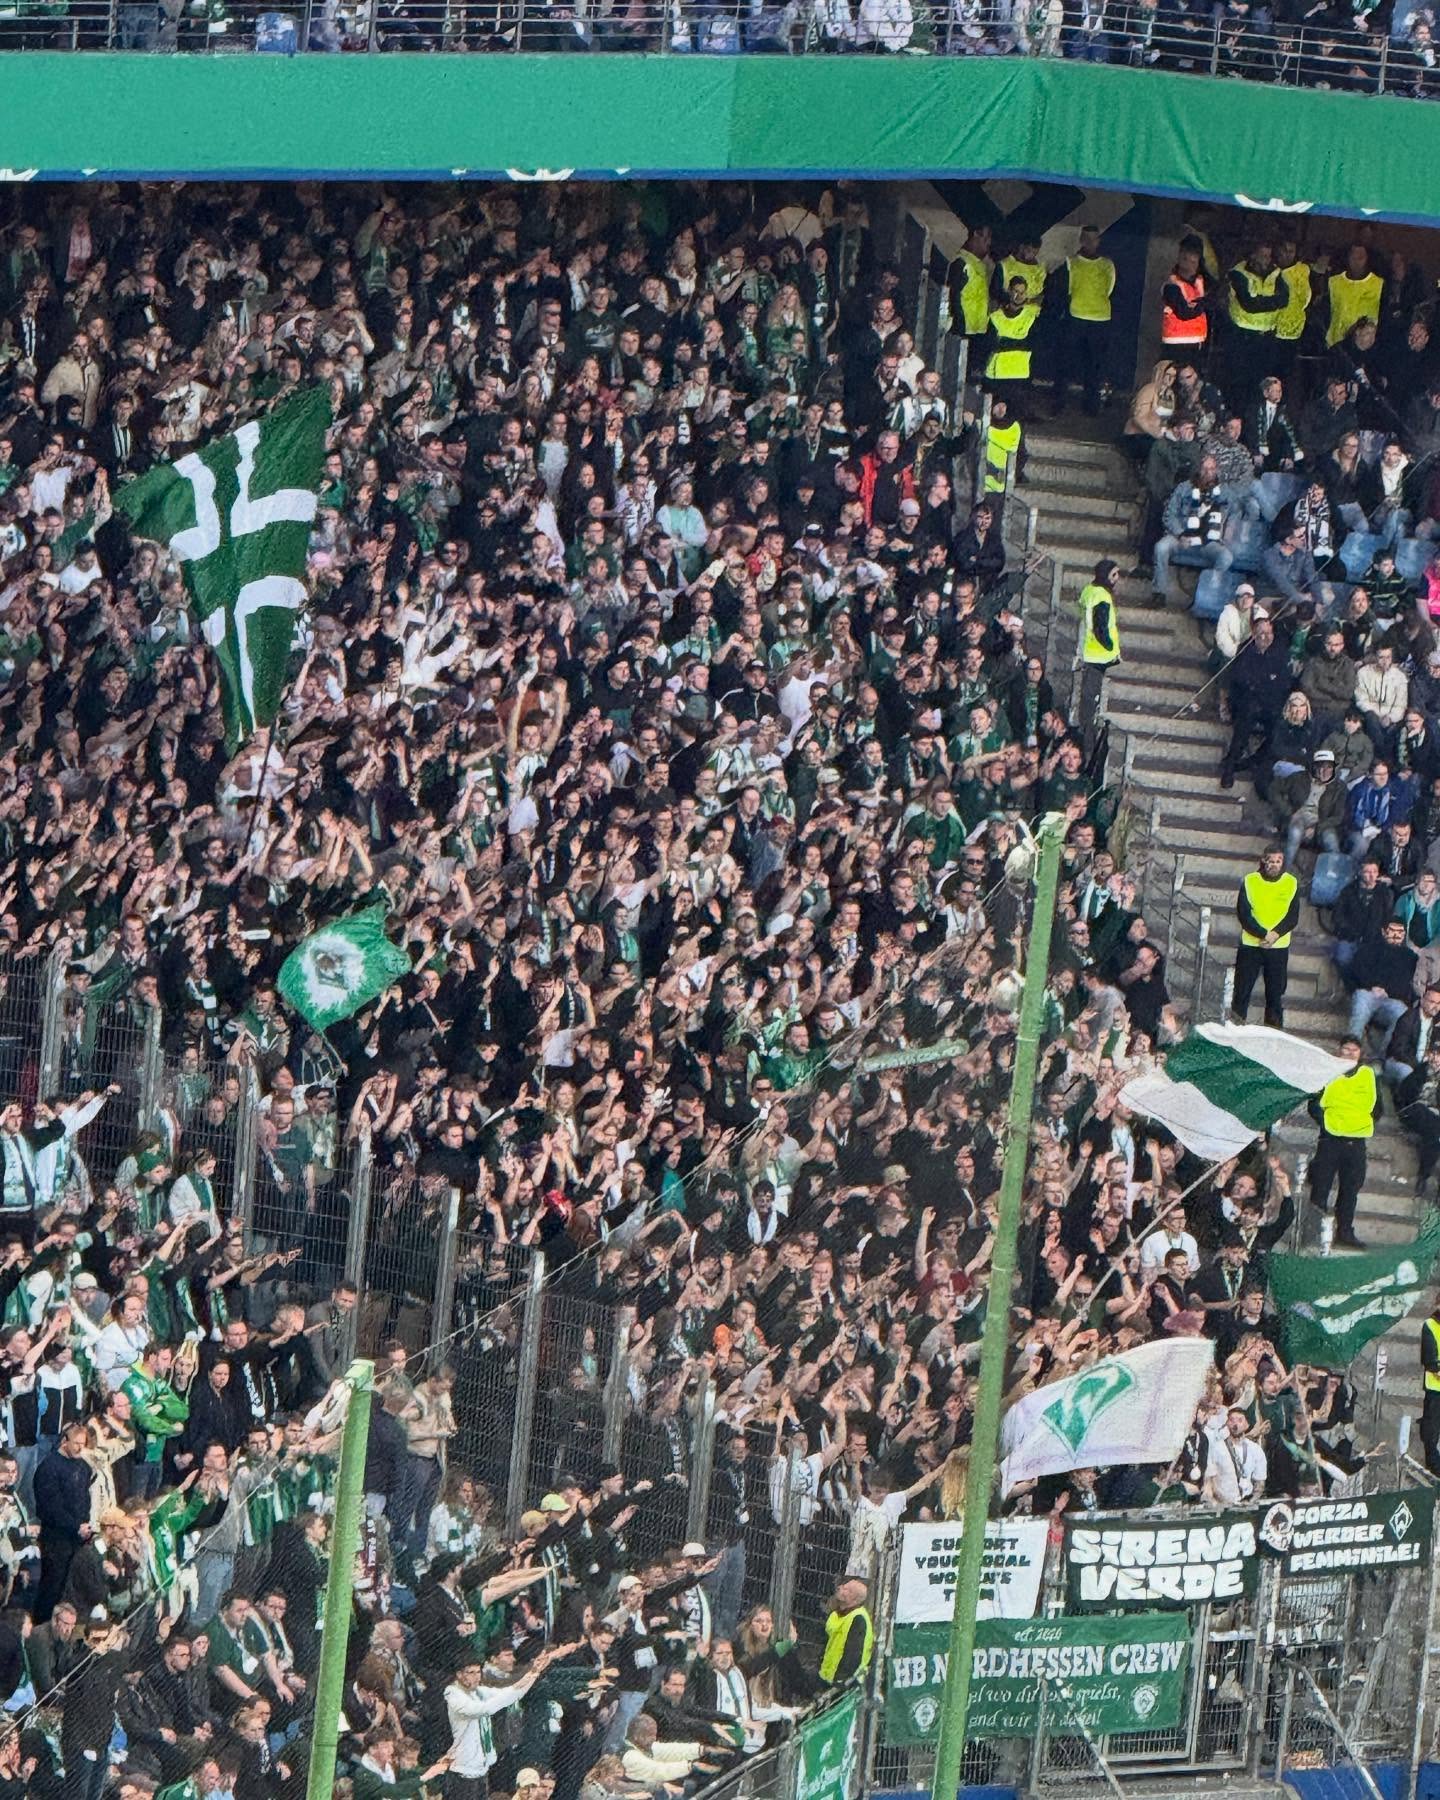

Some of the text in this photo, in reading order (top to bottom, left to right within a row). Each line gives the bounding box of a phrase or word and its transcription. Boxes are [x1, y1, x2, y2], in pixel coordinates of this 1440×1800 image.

[1293, 1502, 1369, 1526] FORZA
[931, 1538, 1018, 1552] SUPORT
[1292, 1524, 1385, 1549] WERDER
[981, 1555, 1031, 1568] OCAL
[1080, 1560, 1244, 1601] VERDE
[943, 1588, 995, 1602] TM
[893, 1641, 1186, 1688] HB NRDHESSEN CREW
